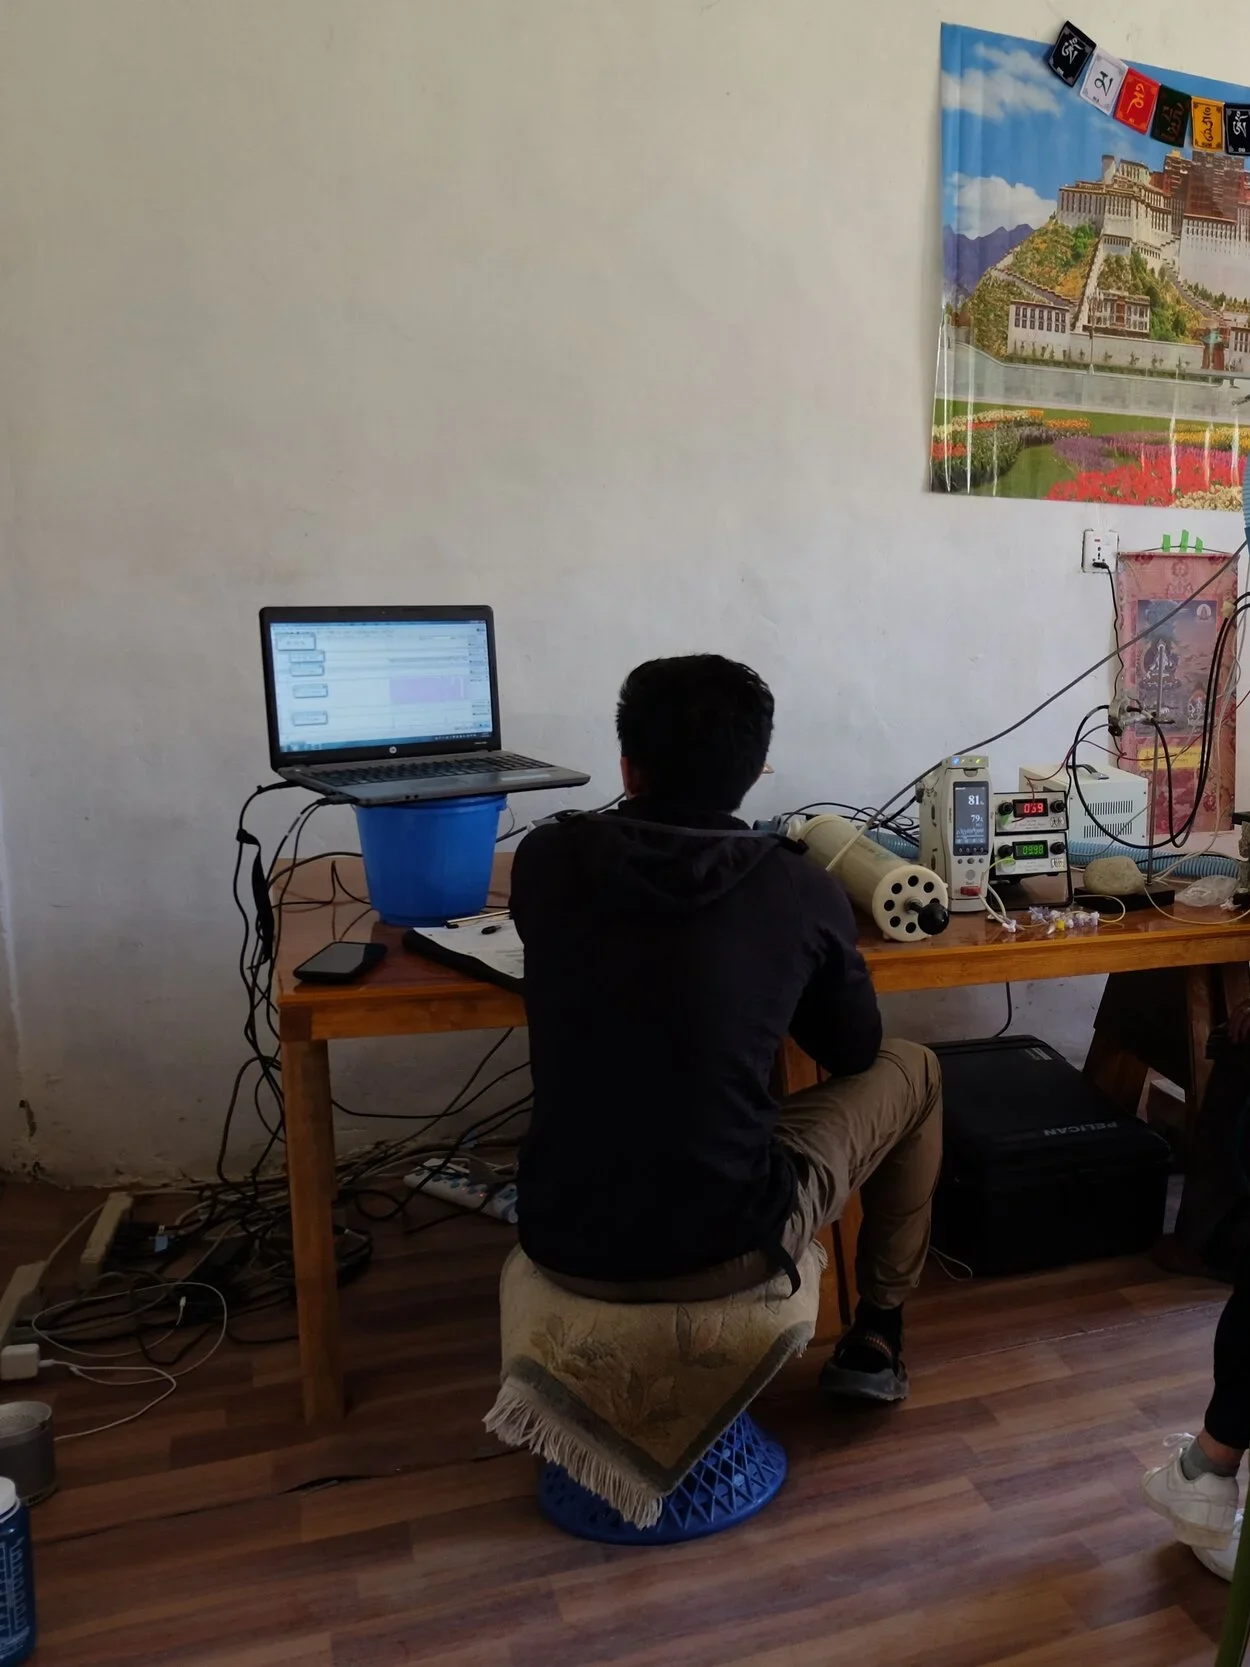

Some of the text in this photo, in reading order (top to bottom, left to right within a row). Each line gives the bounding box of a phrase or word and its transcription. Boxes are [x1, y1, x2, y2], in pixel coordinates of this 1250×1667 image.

[968, 795, 980, 805] 81
[970, 814, 981, 823] 79
[1043, 1121, 1118, 1137] PELICAN
